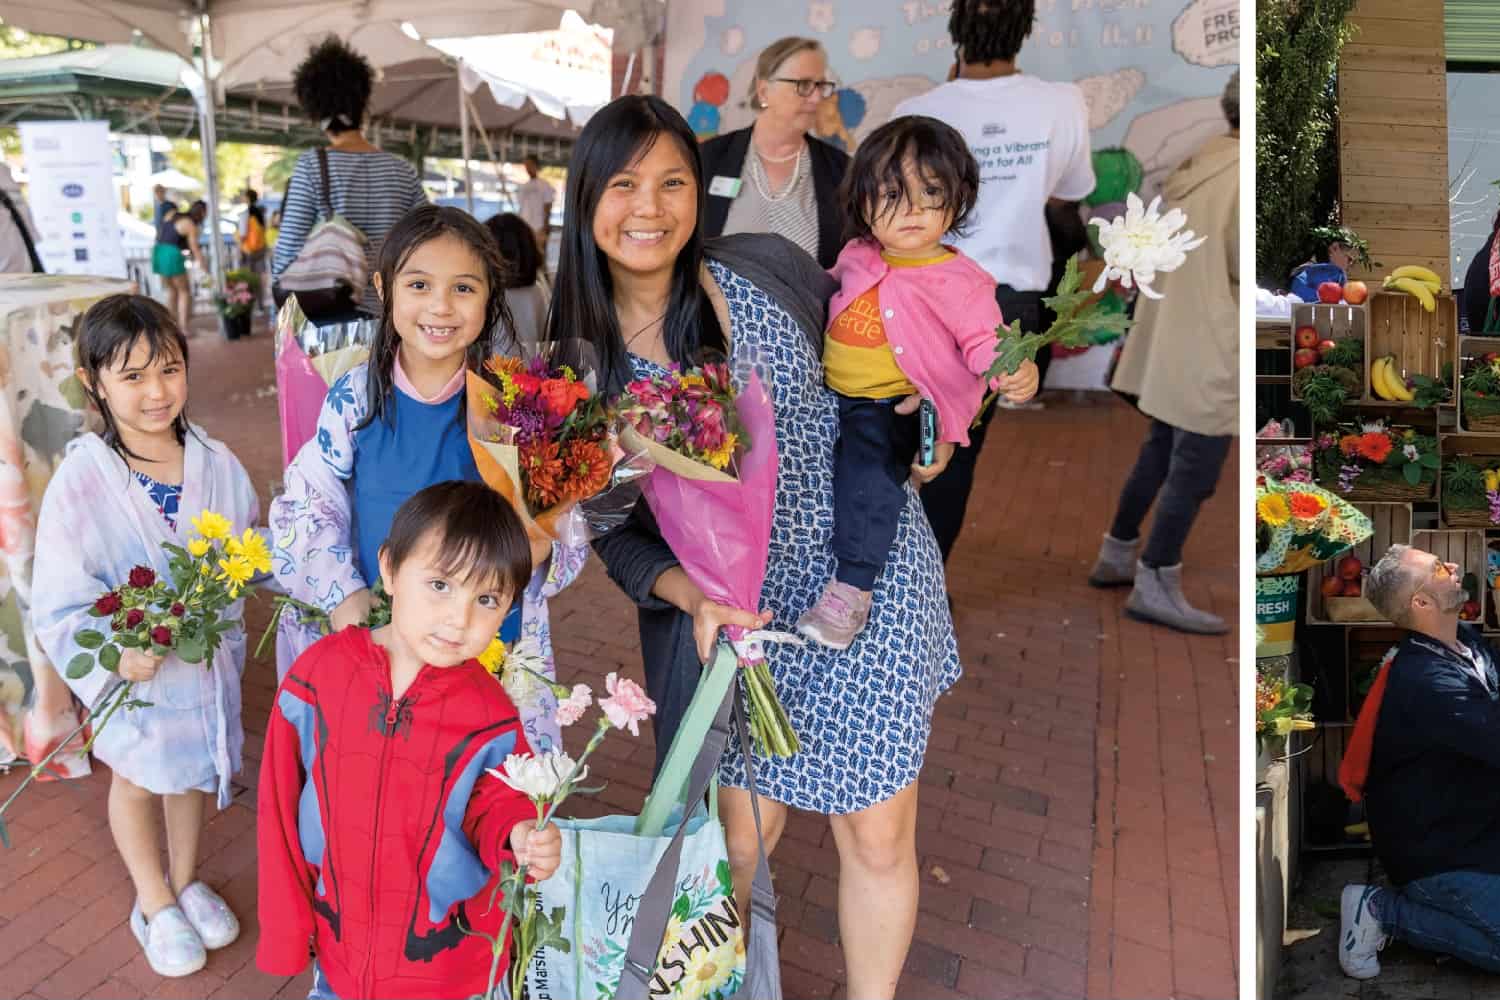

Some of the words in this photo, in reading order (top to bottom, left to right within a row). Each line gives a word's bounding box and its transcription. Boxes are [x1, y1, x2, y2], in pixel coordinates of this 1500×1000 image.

[1256, 600, 1290, 615] RESH
[600, 881, 644, 936] Yo
[533, 944, 548, 990] Marsh
